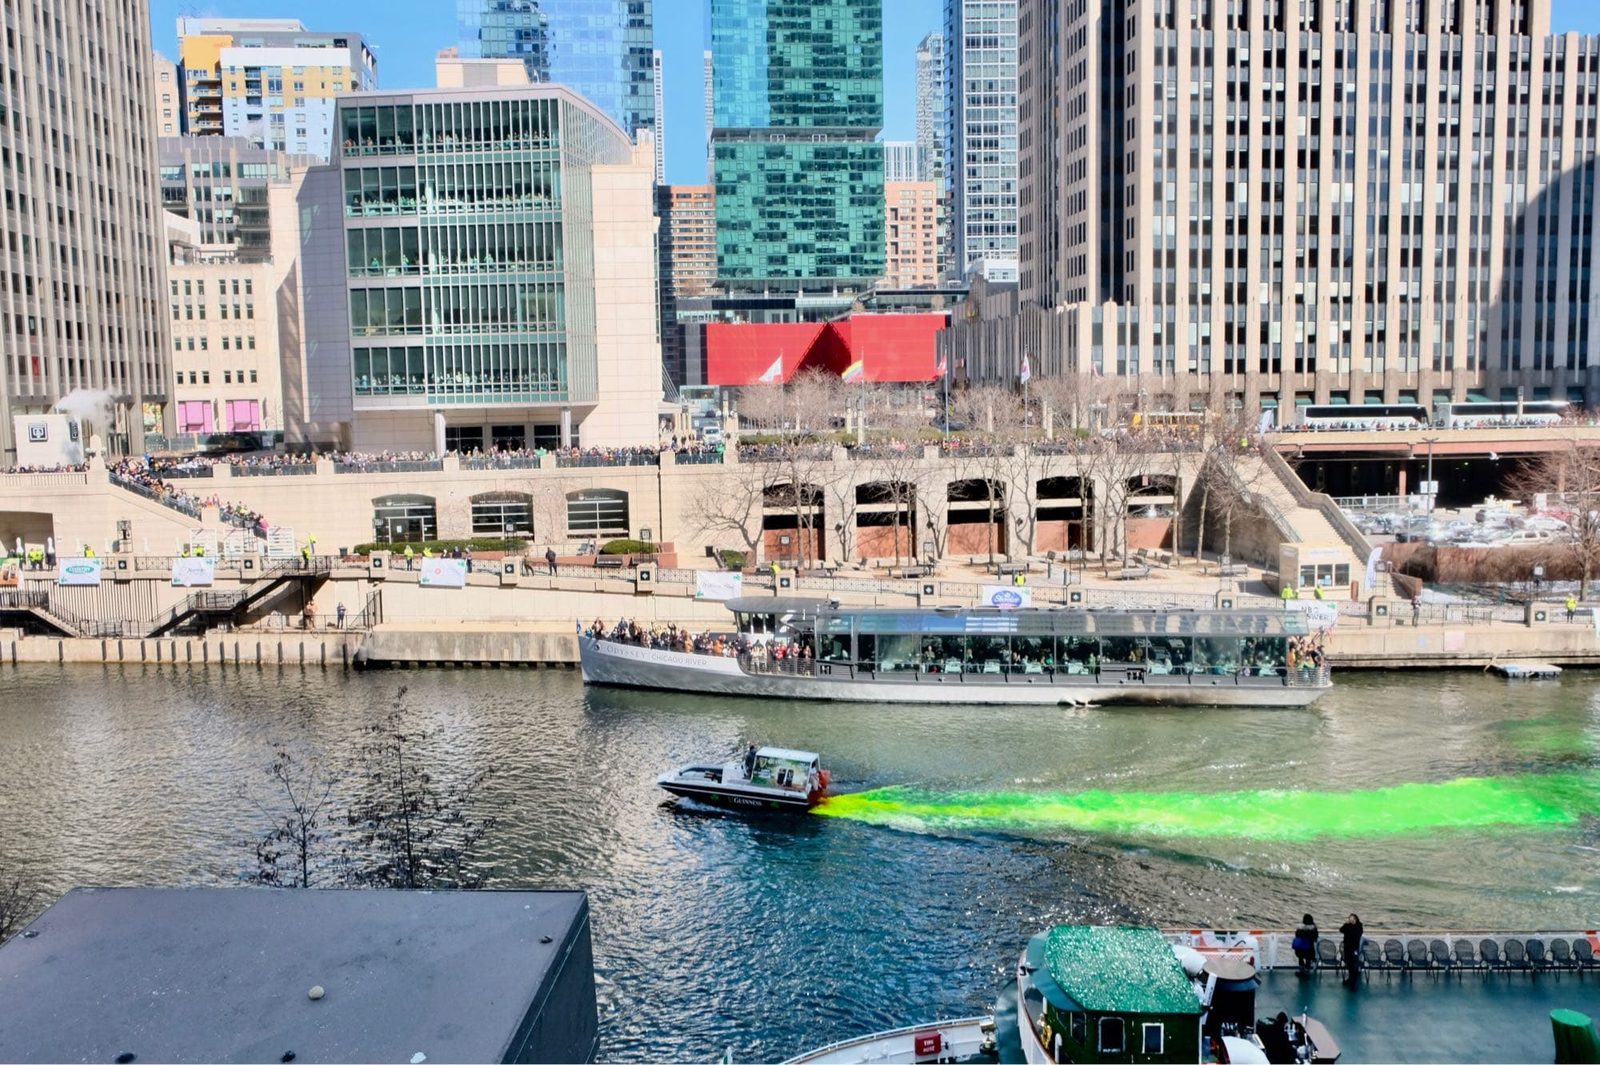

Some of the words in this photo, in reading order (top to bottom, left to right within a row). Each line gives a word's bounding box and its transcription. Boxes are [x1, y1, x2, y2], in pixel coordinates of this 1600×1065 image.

[606, 645, 646, 659] ODYSSEY
[651, 654, 684, 664] CHICAGO
[685, 658, 707, 666] RIVER
[733, 797, 762, 806] GUINNESS
